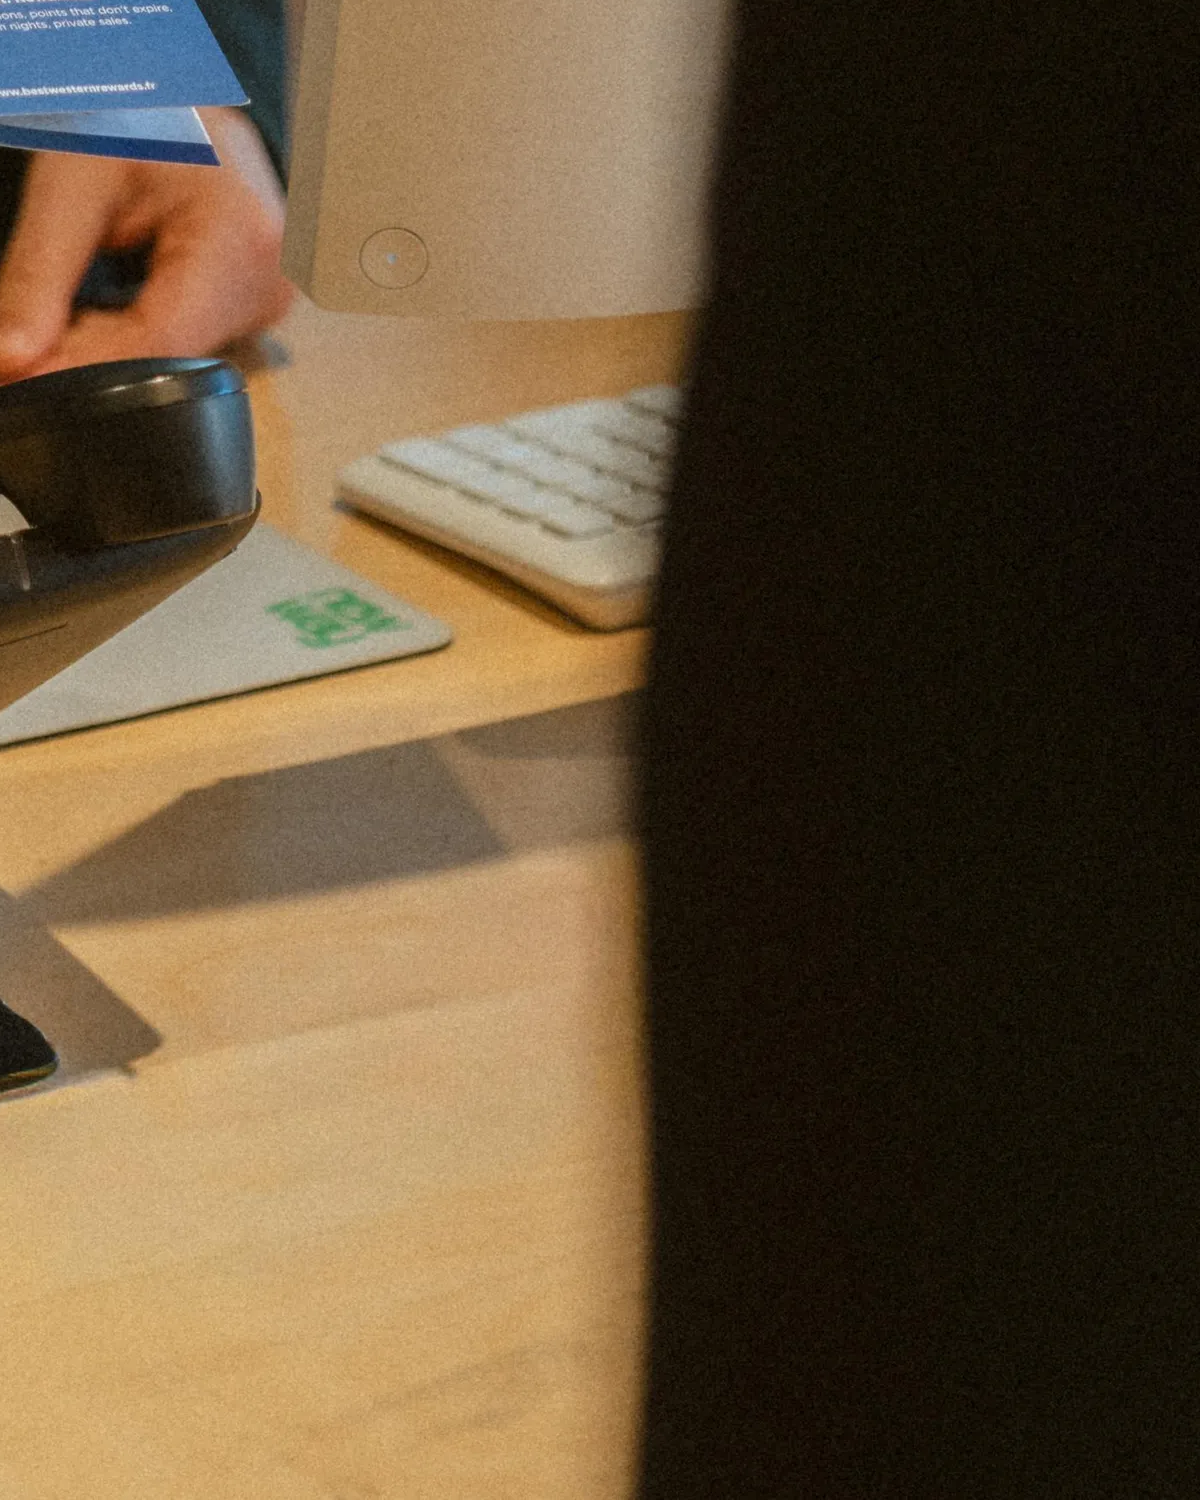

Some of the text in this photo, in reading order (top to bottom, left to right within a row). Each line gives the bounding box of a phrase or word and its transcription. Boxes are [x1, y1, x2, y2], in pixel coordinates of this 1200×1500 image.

[29, 7, 68, 20] points
[70, 5, 95, 16] that
[98, 4, 130, 15] don't
[132, 3, 173, 16] expire,
[9, 19, 51, 32] nights,
[53, 17, 96, 30] private
[98, 16, 132, 27] sales.
